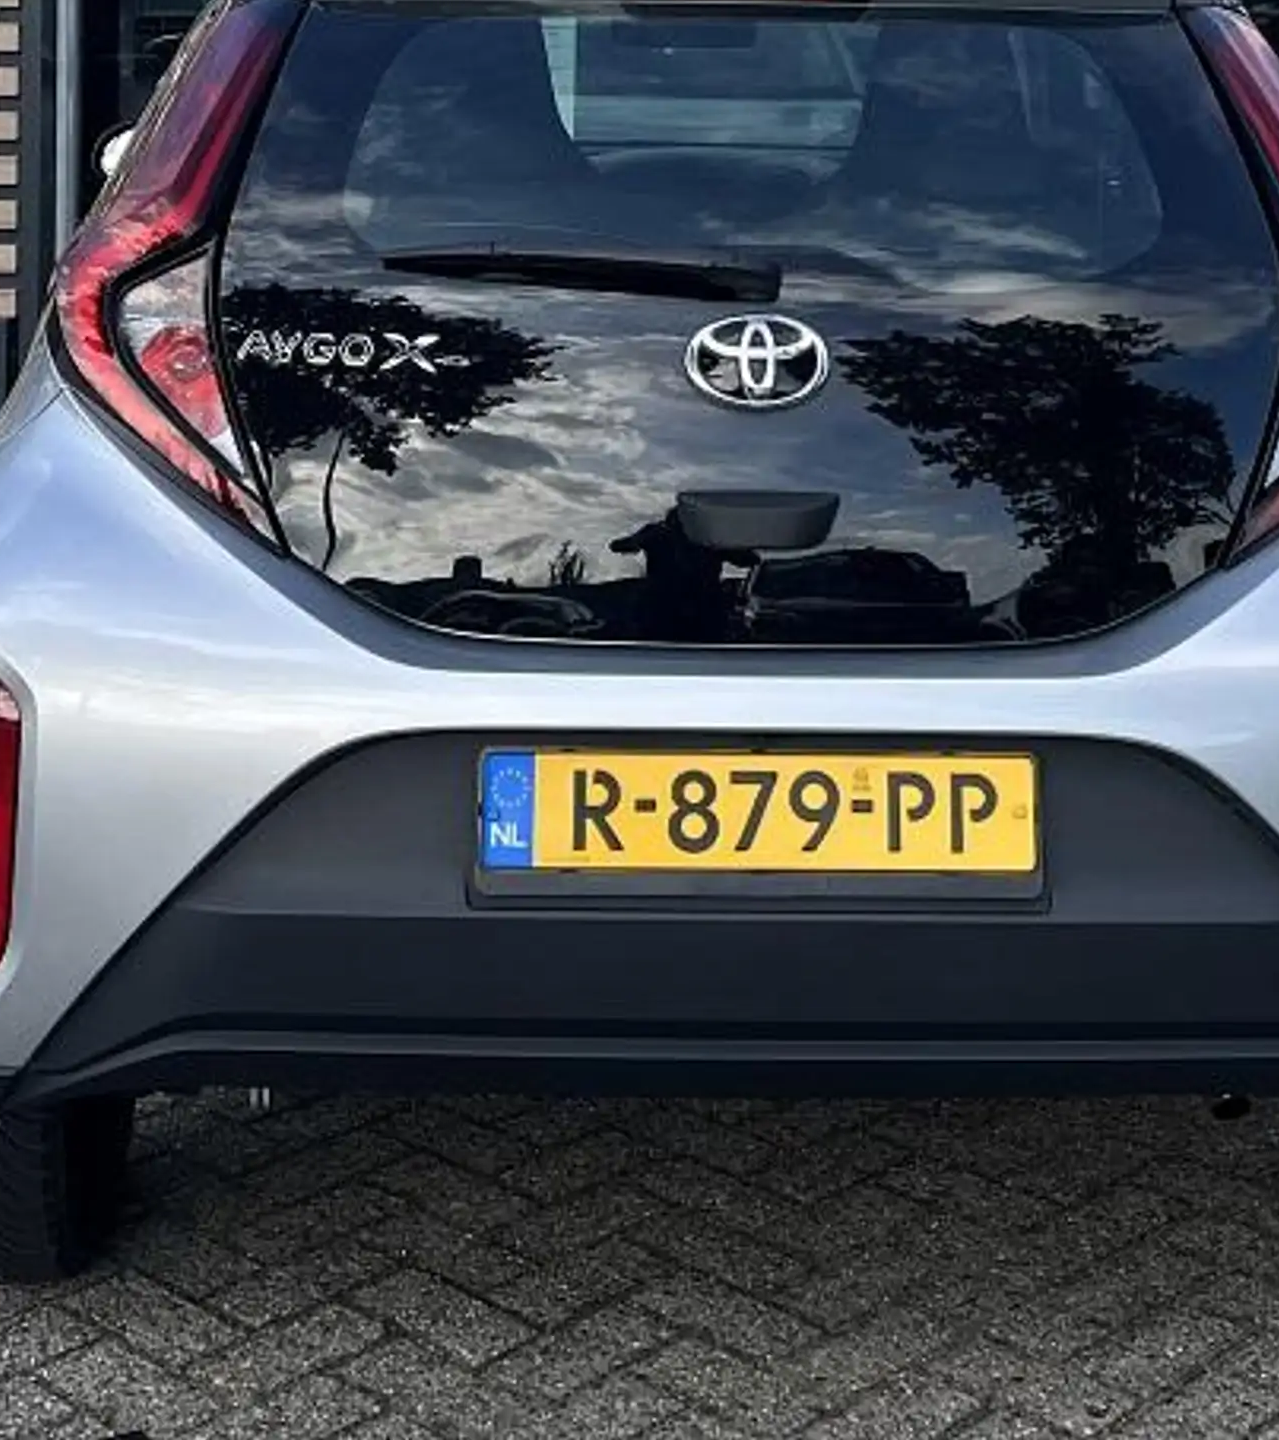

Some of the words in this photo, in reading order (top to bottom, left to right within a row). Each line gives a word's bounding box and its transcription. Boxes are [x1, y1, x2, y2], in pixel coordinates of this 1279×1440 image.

[236, 329, 375, 367] AYGO
[571, 769, 999, 854] R-879-PP
[490, 822, 528, 848] NL
